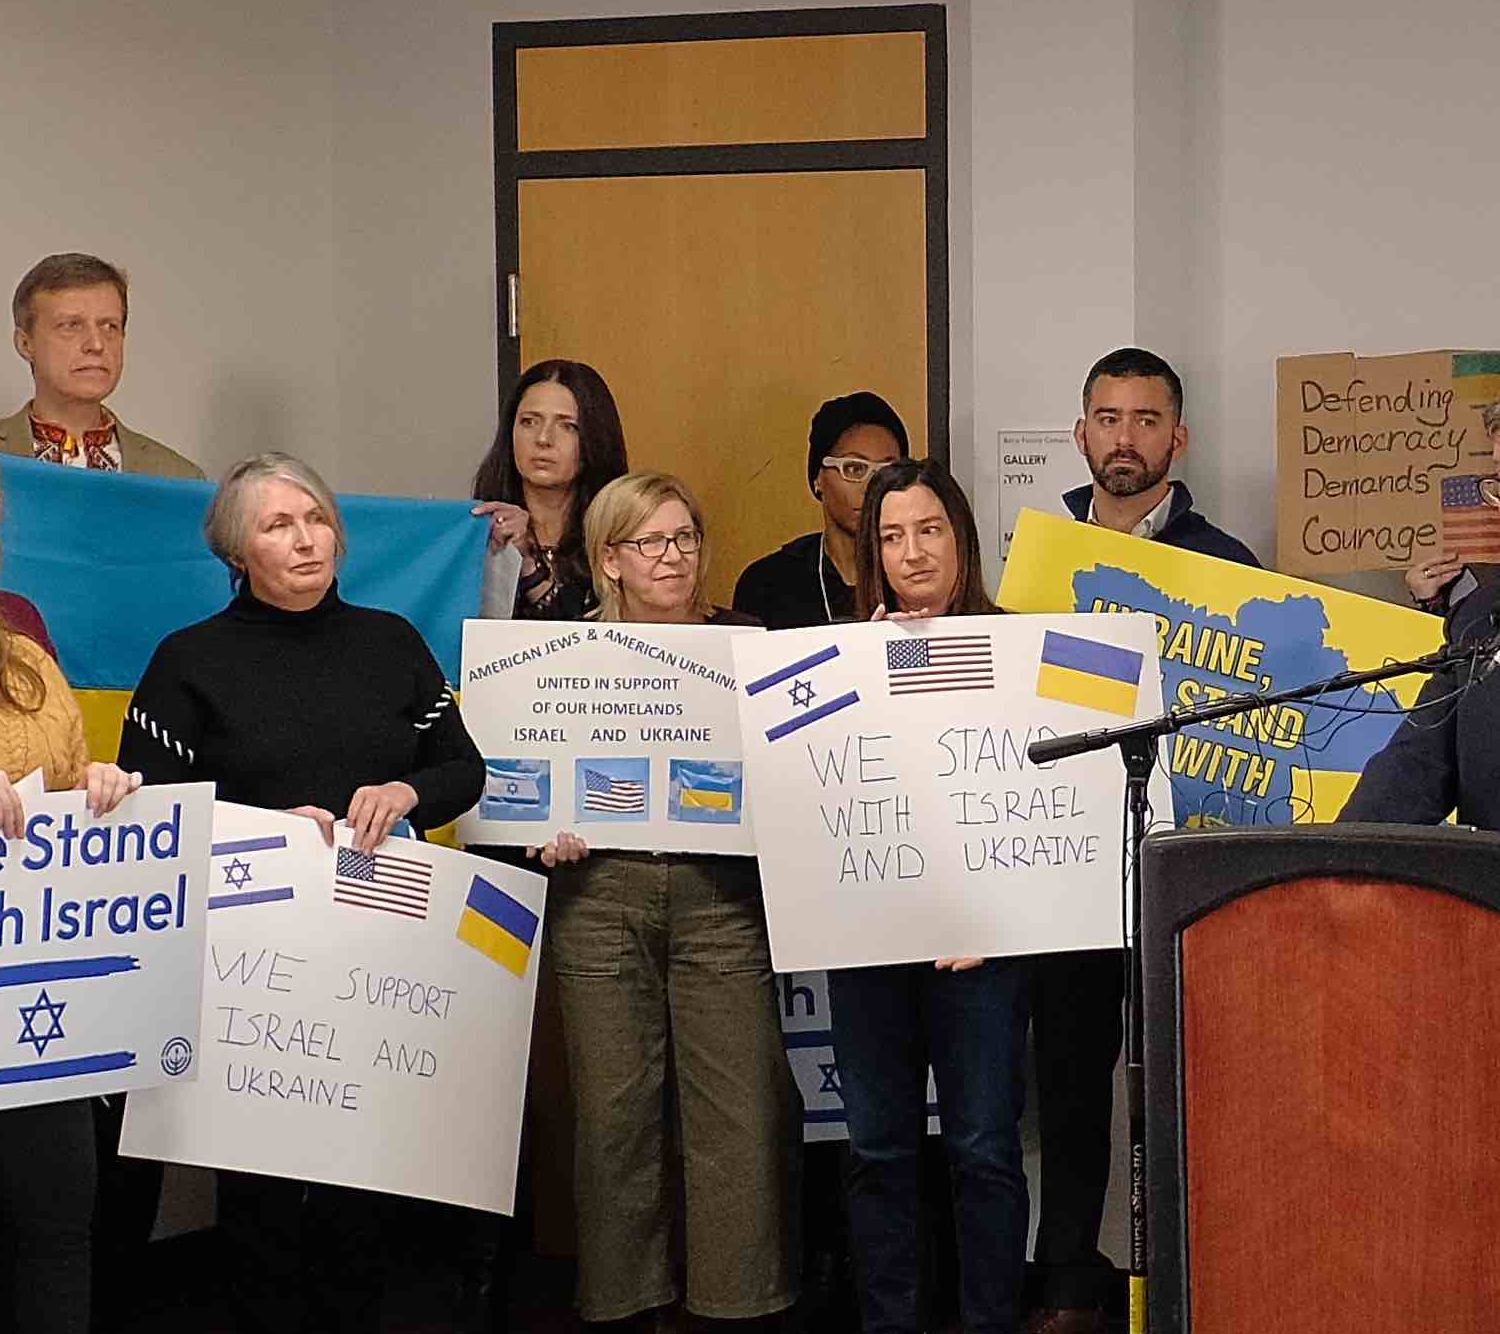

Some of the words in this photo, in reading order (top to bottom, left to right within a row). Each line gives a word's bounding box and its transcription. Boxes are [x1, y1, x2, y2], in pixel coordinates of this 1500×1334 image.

[1301, 378, 1454, 427] Defending
[1003, 454, 1047, 465] GALLERY
[1303, 426, 1467, 472] Democracy
[1304, 466, 1430, 499] Demands
[1303, 515, 1437, 561] Courage
[468, 646, 542, 683] AMERICAN
[544, 631, 581, 655] JEWS
[587, 628, 598, 641] &
[604, 629, 683, 667] AMERICAN
[679, 656, 738, 691] UKRAINI
[1092, 598, 1273, 692] RAINE,
[532, 701, 551, 714] OF
[555, 701, 587, 715] OUR
[591, 701, 684, 716] HOMELANDS
[536, 677, 590, 690] UNITED
[595, 677, 609, 690] IN
[614, 677, 681, 690] SUPPORT
[514, 728, 568, 742] ISRAEL
[590, 728, 627, 742] AND
[639, 727, 712, 742] UKRAINE
[807, 733, 897, 787] WE
[1172, 734, 1276, 797] WITH
[22, 803, 182, 871] Stand
[820, 795, 911, 838] WITH
[949, 786, 1085, 825] ISRAEL
[839, 844, 925, 884] AND
[964, 834, 1100, 871] UKRAINE
[41, 874, 188, 942] Israel
[211, 943, 307, 993] WE
[334, 967, 458, 1019] SUPPORT
[216, 1006, 341, 1061] ISRAEL
[372, 1038, 437, 1078] AND
[226, 1063, 364, 1110] UKRAINE
